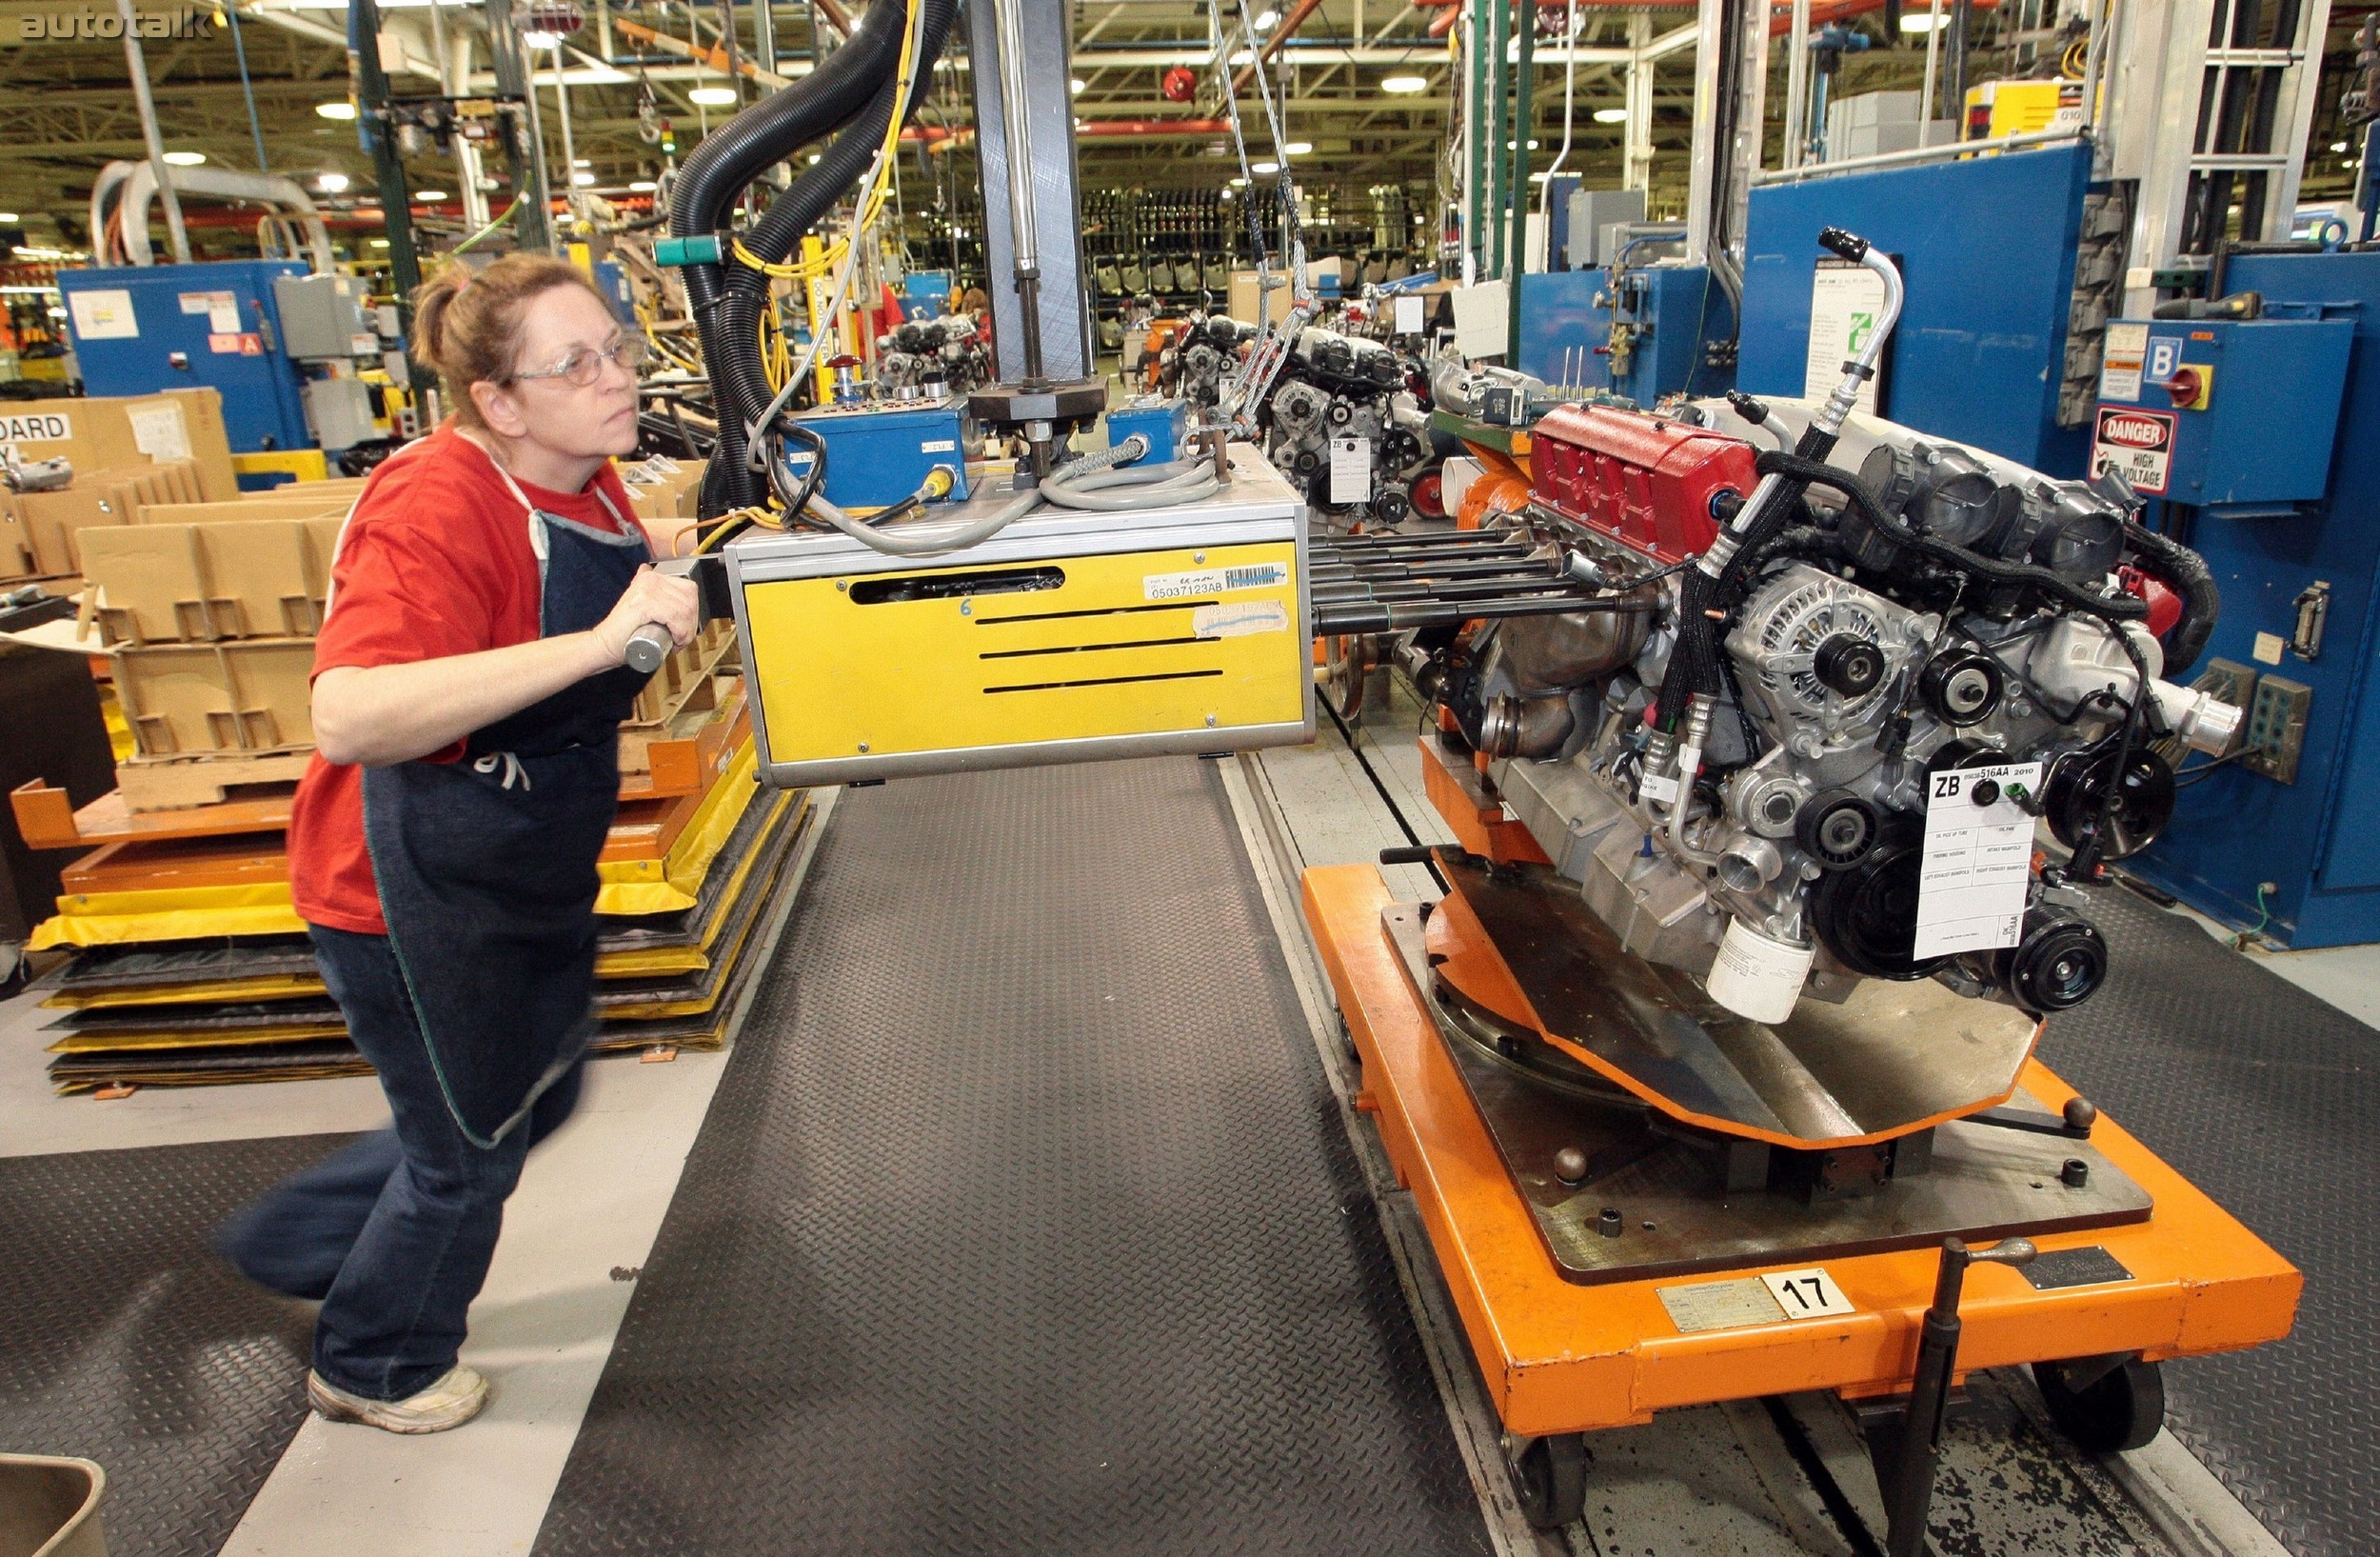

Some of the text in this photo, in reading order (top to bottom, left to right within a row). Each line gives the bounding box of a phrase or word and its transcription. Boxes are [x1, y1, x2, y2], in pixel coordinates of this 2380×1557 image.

[2152, 345, 2173, 376] B
[2107, 420, 2161, 444] DANGER
[2133, 452, 2154, 468] HIGH
[2123, 467, 2161, 486] VOLTAGE
[1152, 582, 1222, 599] 05037123AB
[961, 598, 972, 616] 6
[2013, 768, 2034, 776] 2010
[1934, 775, 1960, 798] ZB
[1782, 1277, 1828, 1309] 17
